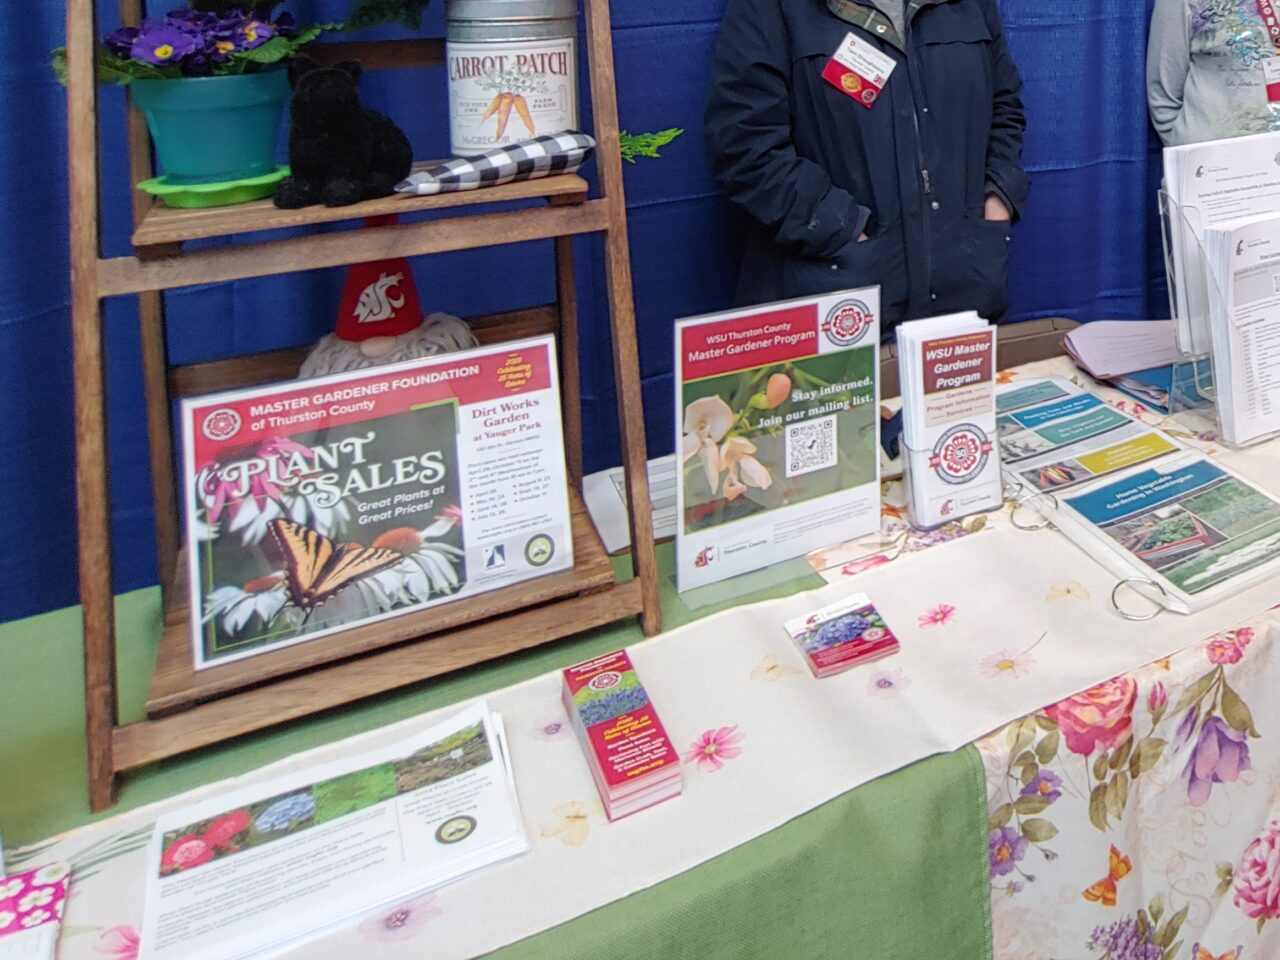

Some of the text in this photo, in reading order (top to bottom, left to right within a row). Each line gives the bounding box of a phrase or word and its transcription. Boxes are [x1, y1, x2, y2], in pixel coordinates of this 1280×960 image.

[451, 51, 569, 82] CARROT PATCH
[688, 330, 816, 363] Master Gardener Program
[706, 322, 792, 345] WSU Thurston County
[926, 342, 991, 361] WSU Master
[934, 357, 984, 374] Gardener
[250, 365, 480, 417] MASTER GARDENER FOUNDATION
[791, 376, 874, 403] Stay informed.
[936, 372, 981, 389] Program
[251, 399, 376, 432] of Thurston County
[472, 398, 540, 419] Dirt Works
[483, 412, 530, 428] Garden
[757, 395, 874, 429] Join our mailing list.
[472, 434, 482, 442] at
[484, 426, 518, 440] Yauger
[519, 421, 542, 432] Park
[223, 431, 376, 497] PLANT
[300, 450, 447, 508] SALES
[357, 484, 445, 513] Great Plants at
[357, 499, 434, 526] Great Prices!
